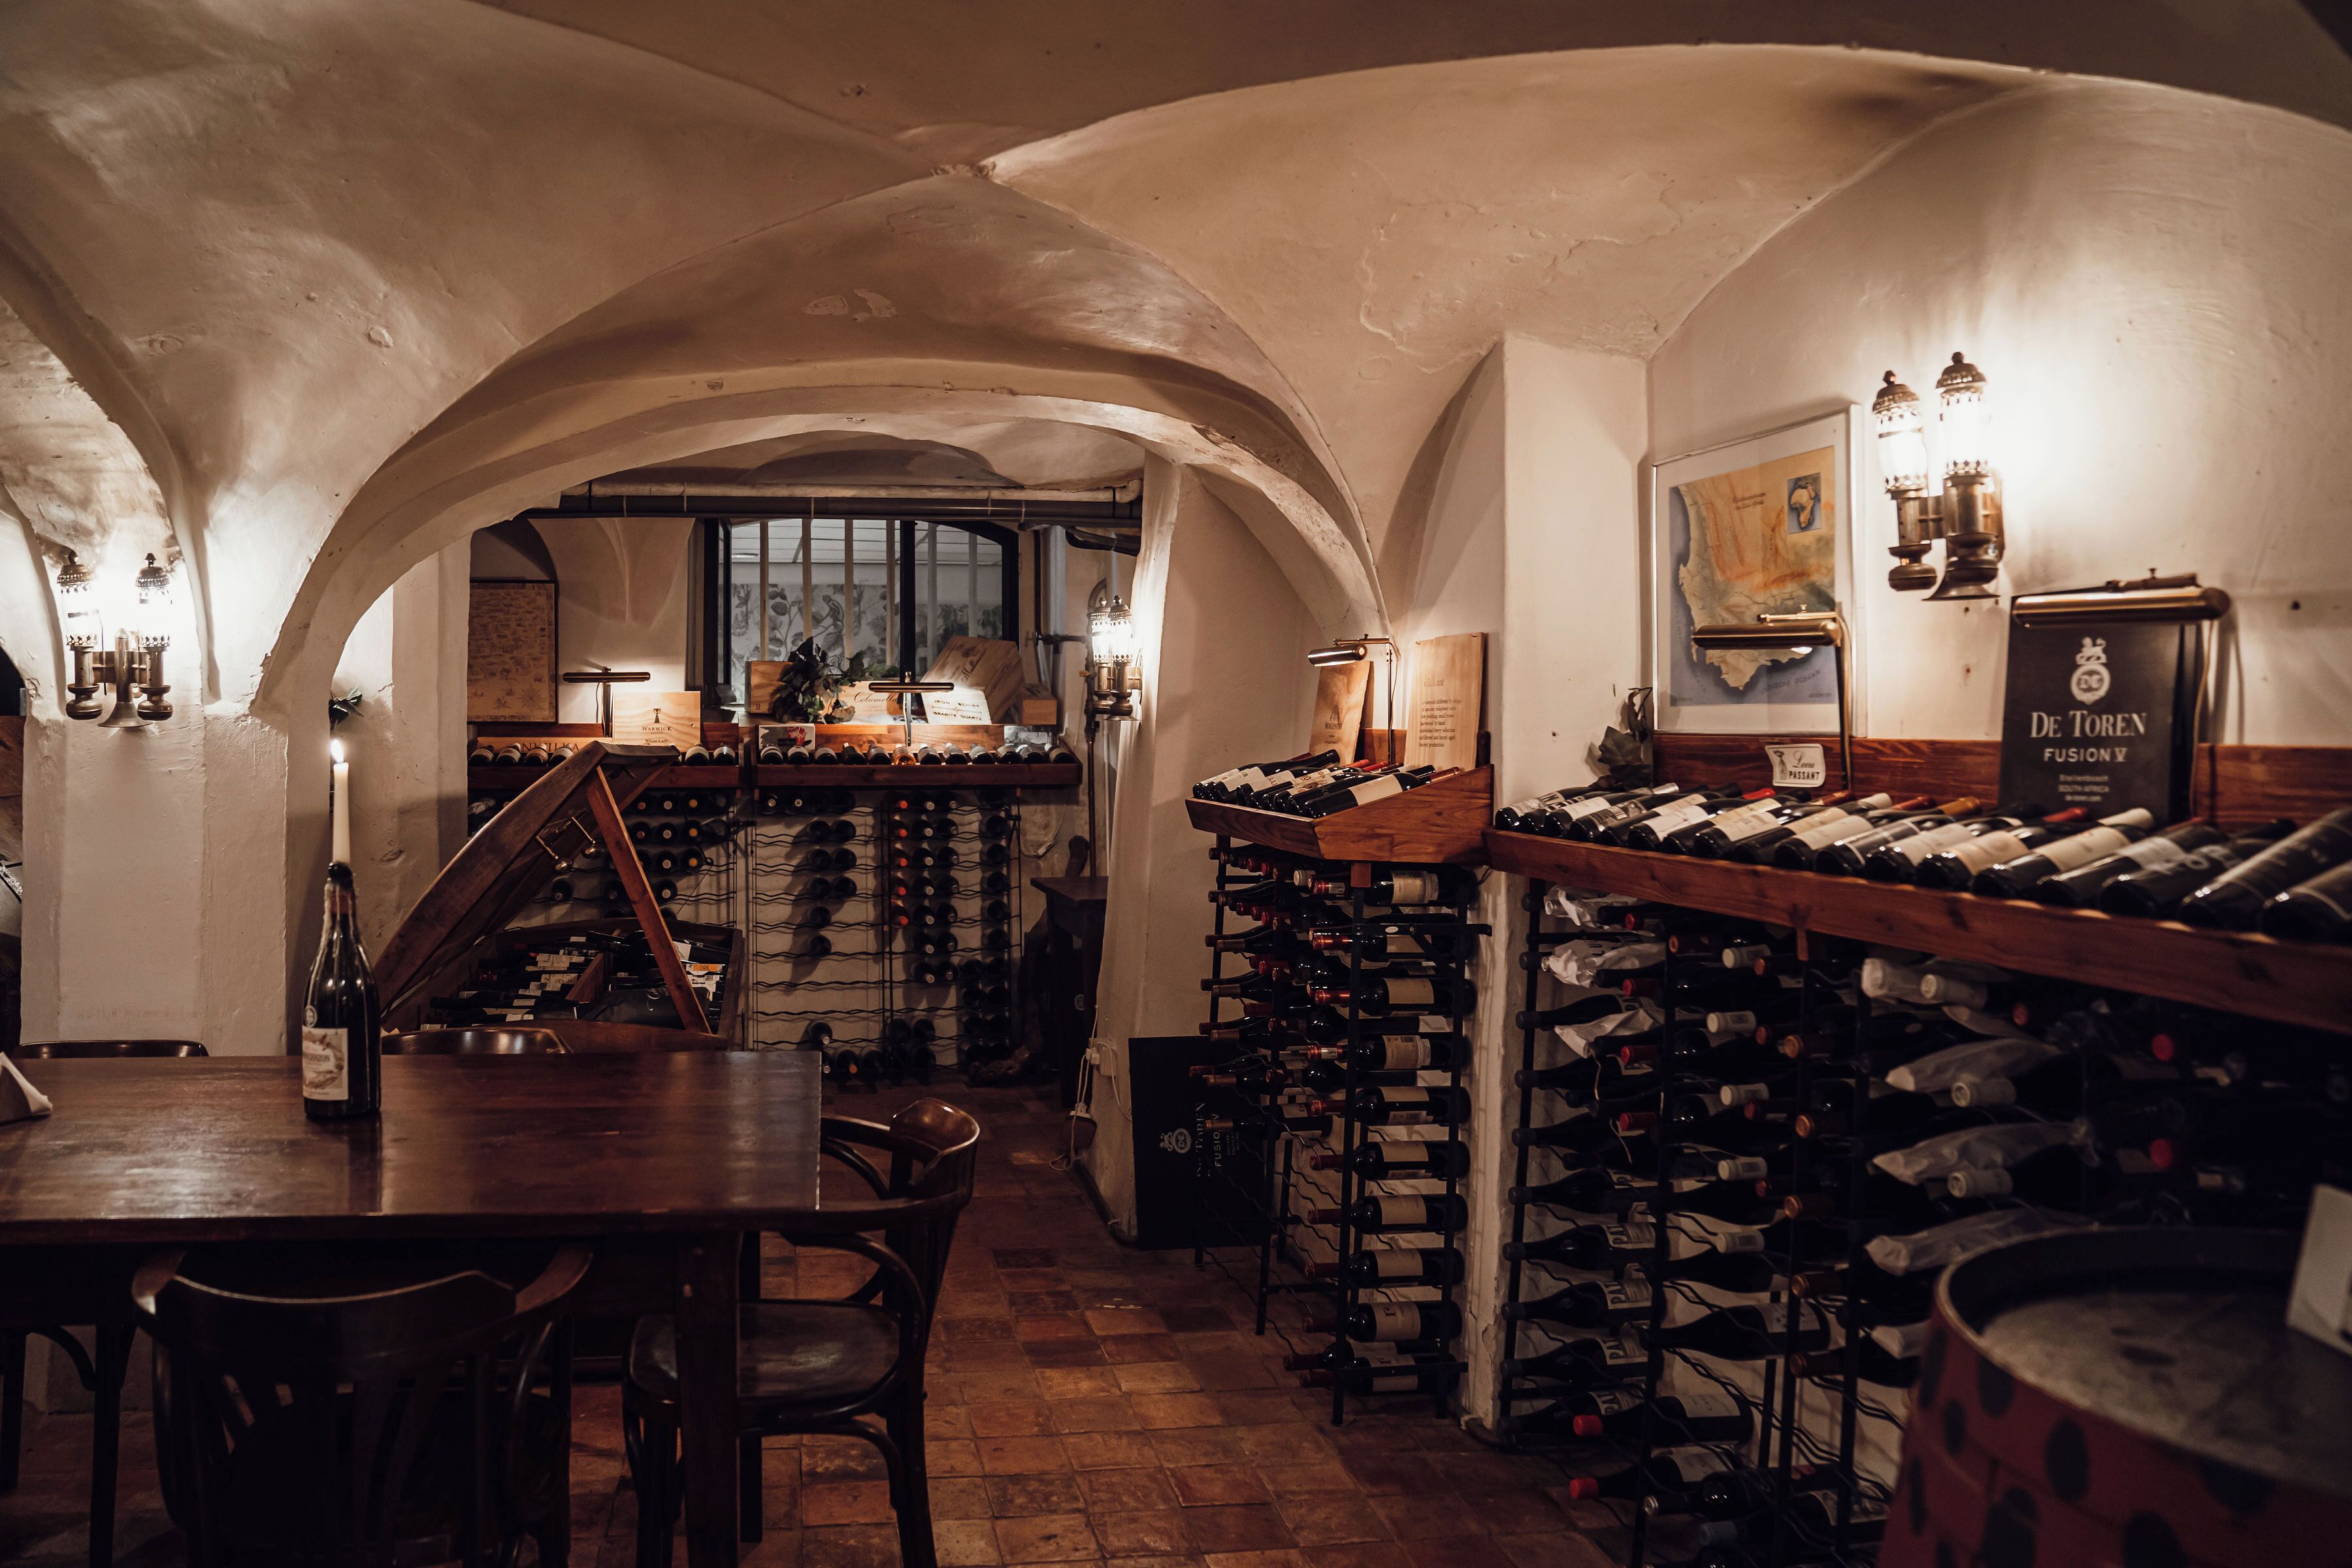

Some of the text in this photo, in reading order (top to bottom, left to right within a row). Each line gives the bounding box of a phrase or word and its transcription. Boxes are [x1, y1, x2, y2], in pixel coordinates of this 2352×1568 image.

[2029, 710, 2148, 738] DE TOREN
[2042, 747, 2129, 763] FUSION V
[1788, 770, 1820, 781] PASSANT
[1213, 1129, 1223, 1168] FUSIO
